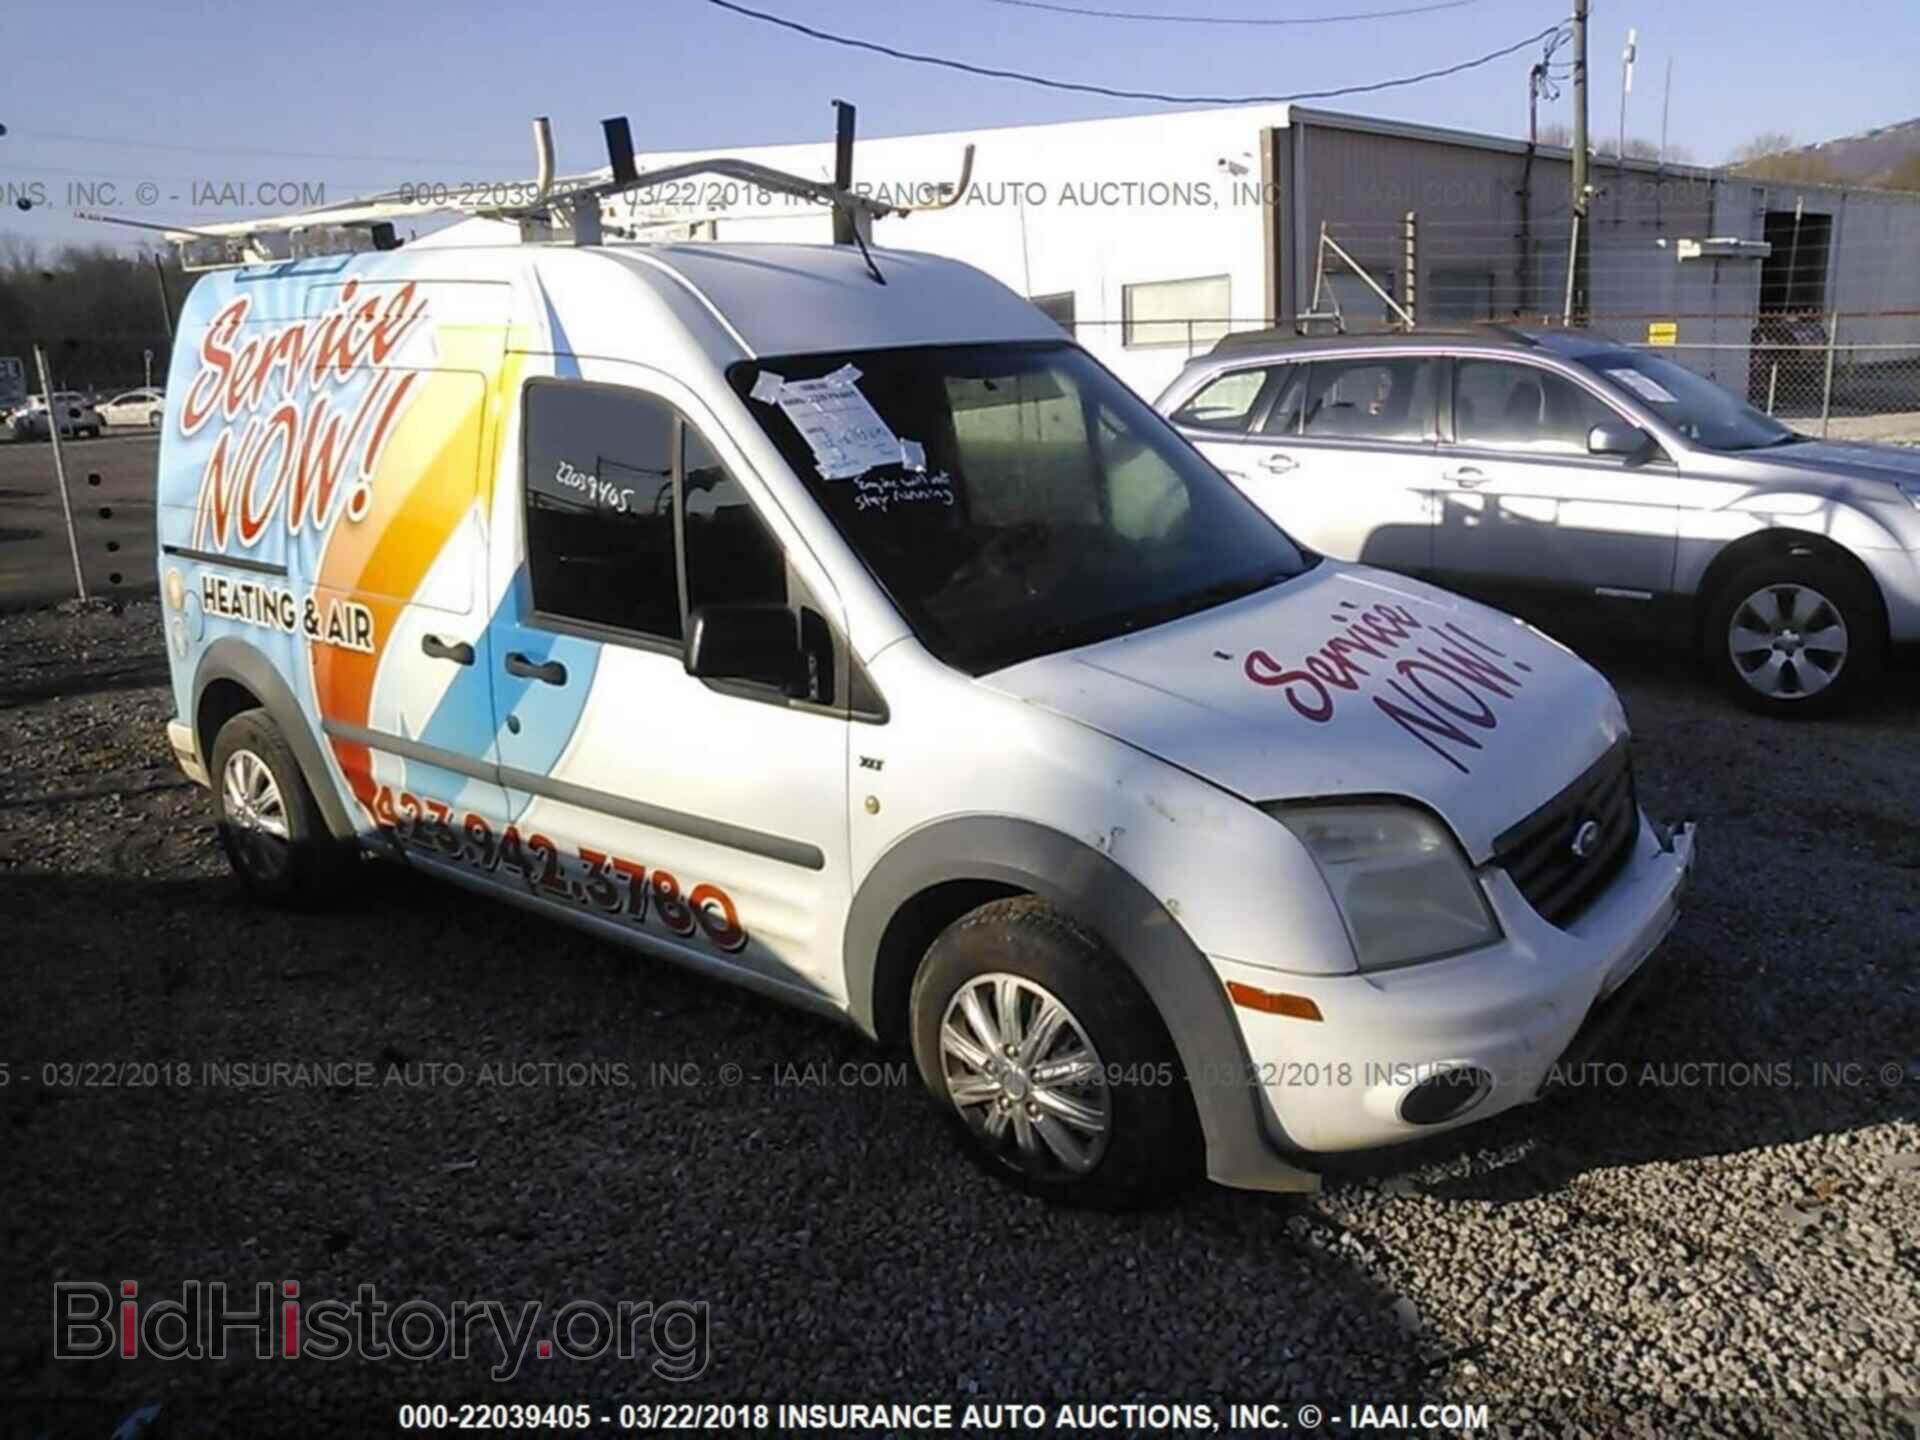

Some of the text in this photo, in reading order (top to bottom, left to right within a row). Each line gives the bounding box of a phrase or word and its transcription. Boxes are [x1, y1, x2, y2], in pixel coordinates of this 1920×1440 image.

[181, 279, 430, 437] Service
[193, 372, 417, 552] NOW!
[556, 461, 635, 512] 22039405
[202, 575, 371, 649] HEATING & AIR
[1245, 604, 1422, 723] Service
[1373, 622, 1532, 775] NOW!
